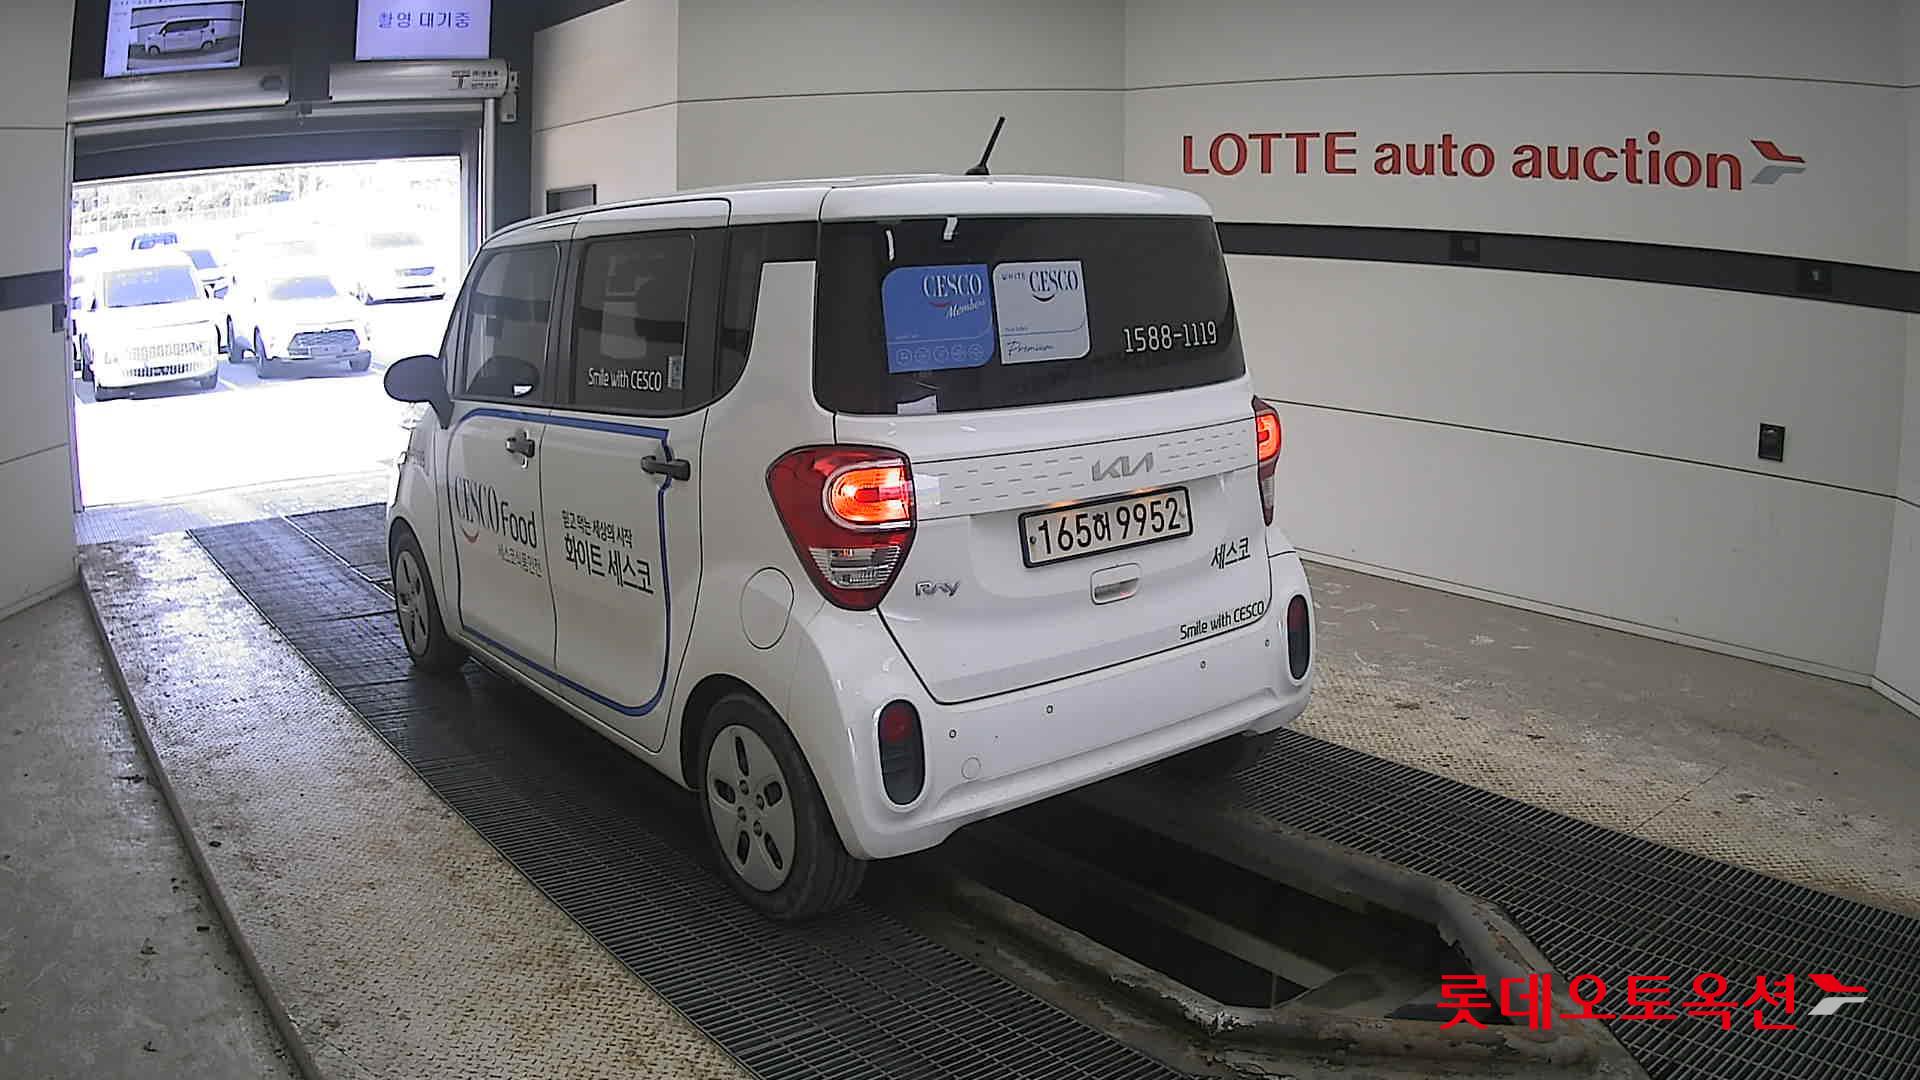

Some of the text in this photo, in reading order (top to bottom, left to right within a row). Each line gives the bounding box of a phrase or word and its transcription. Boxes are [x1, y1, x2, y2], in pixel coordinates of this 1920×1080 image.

[419, 11, 471, 29] 대기중
[1183, 130, 1743, 191] LOTTE auto auction
[922, 272, 983, 298] CESCO
[1029, 269, 1079, 293] CESCO
[1123, 320, 1218, 354] 1588-1119
[588, 367, 662, 393] Smile with CESCO
[1091, 452, 1155, 482] KIA
[455, 475, 538, 550] CESCO Food
[1038, 497, 1181, 555] 165허 9952
[592, 519, 616, 543] 세상의
[616, 526, 633, 549] 시작
[564, 532, 655, 595] 화이트 세스코
[1210, 536, 1251, 569] 세스코
[1180, 600, 1265, 641] Smile with CESCO
